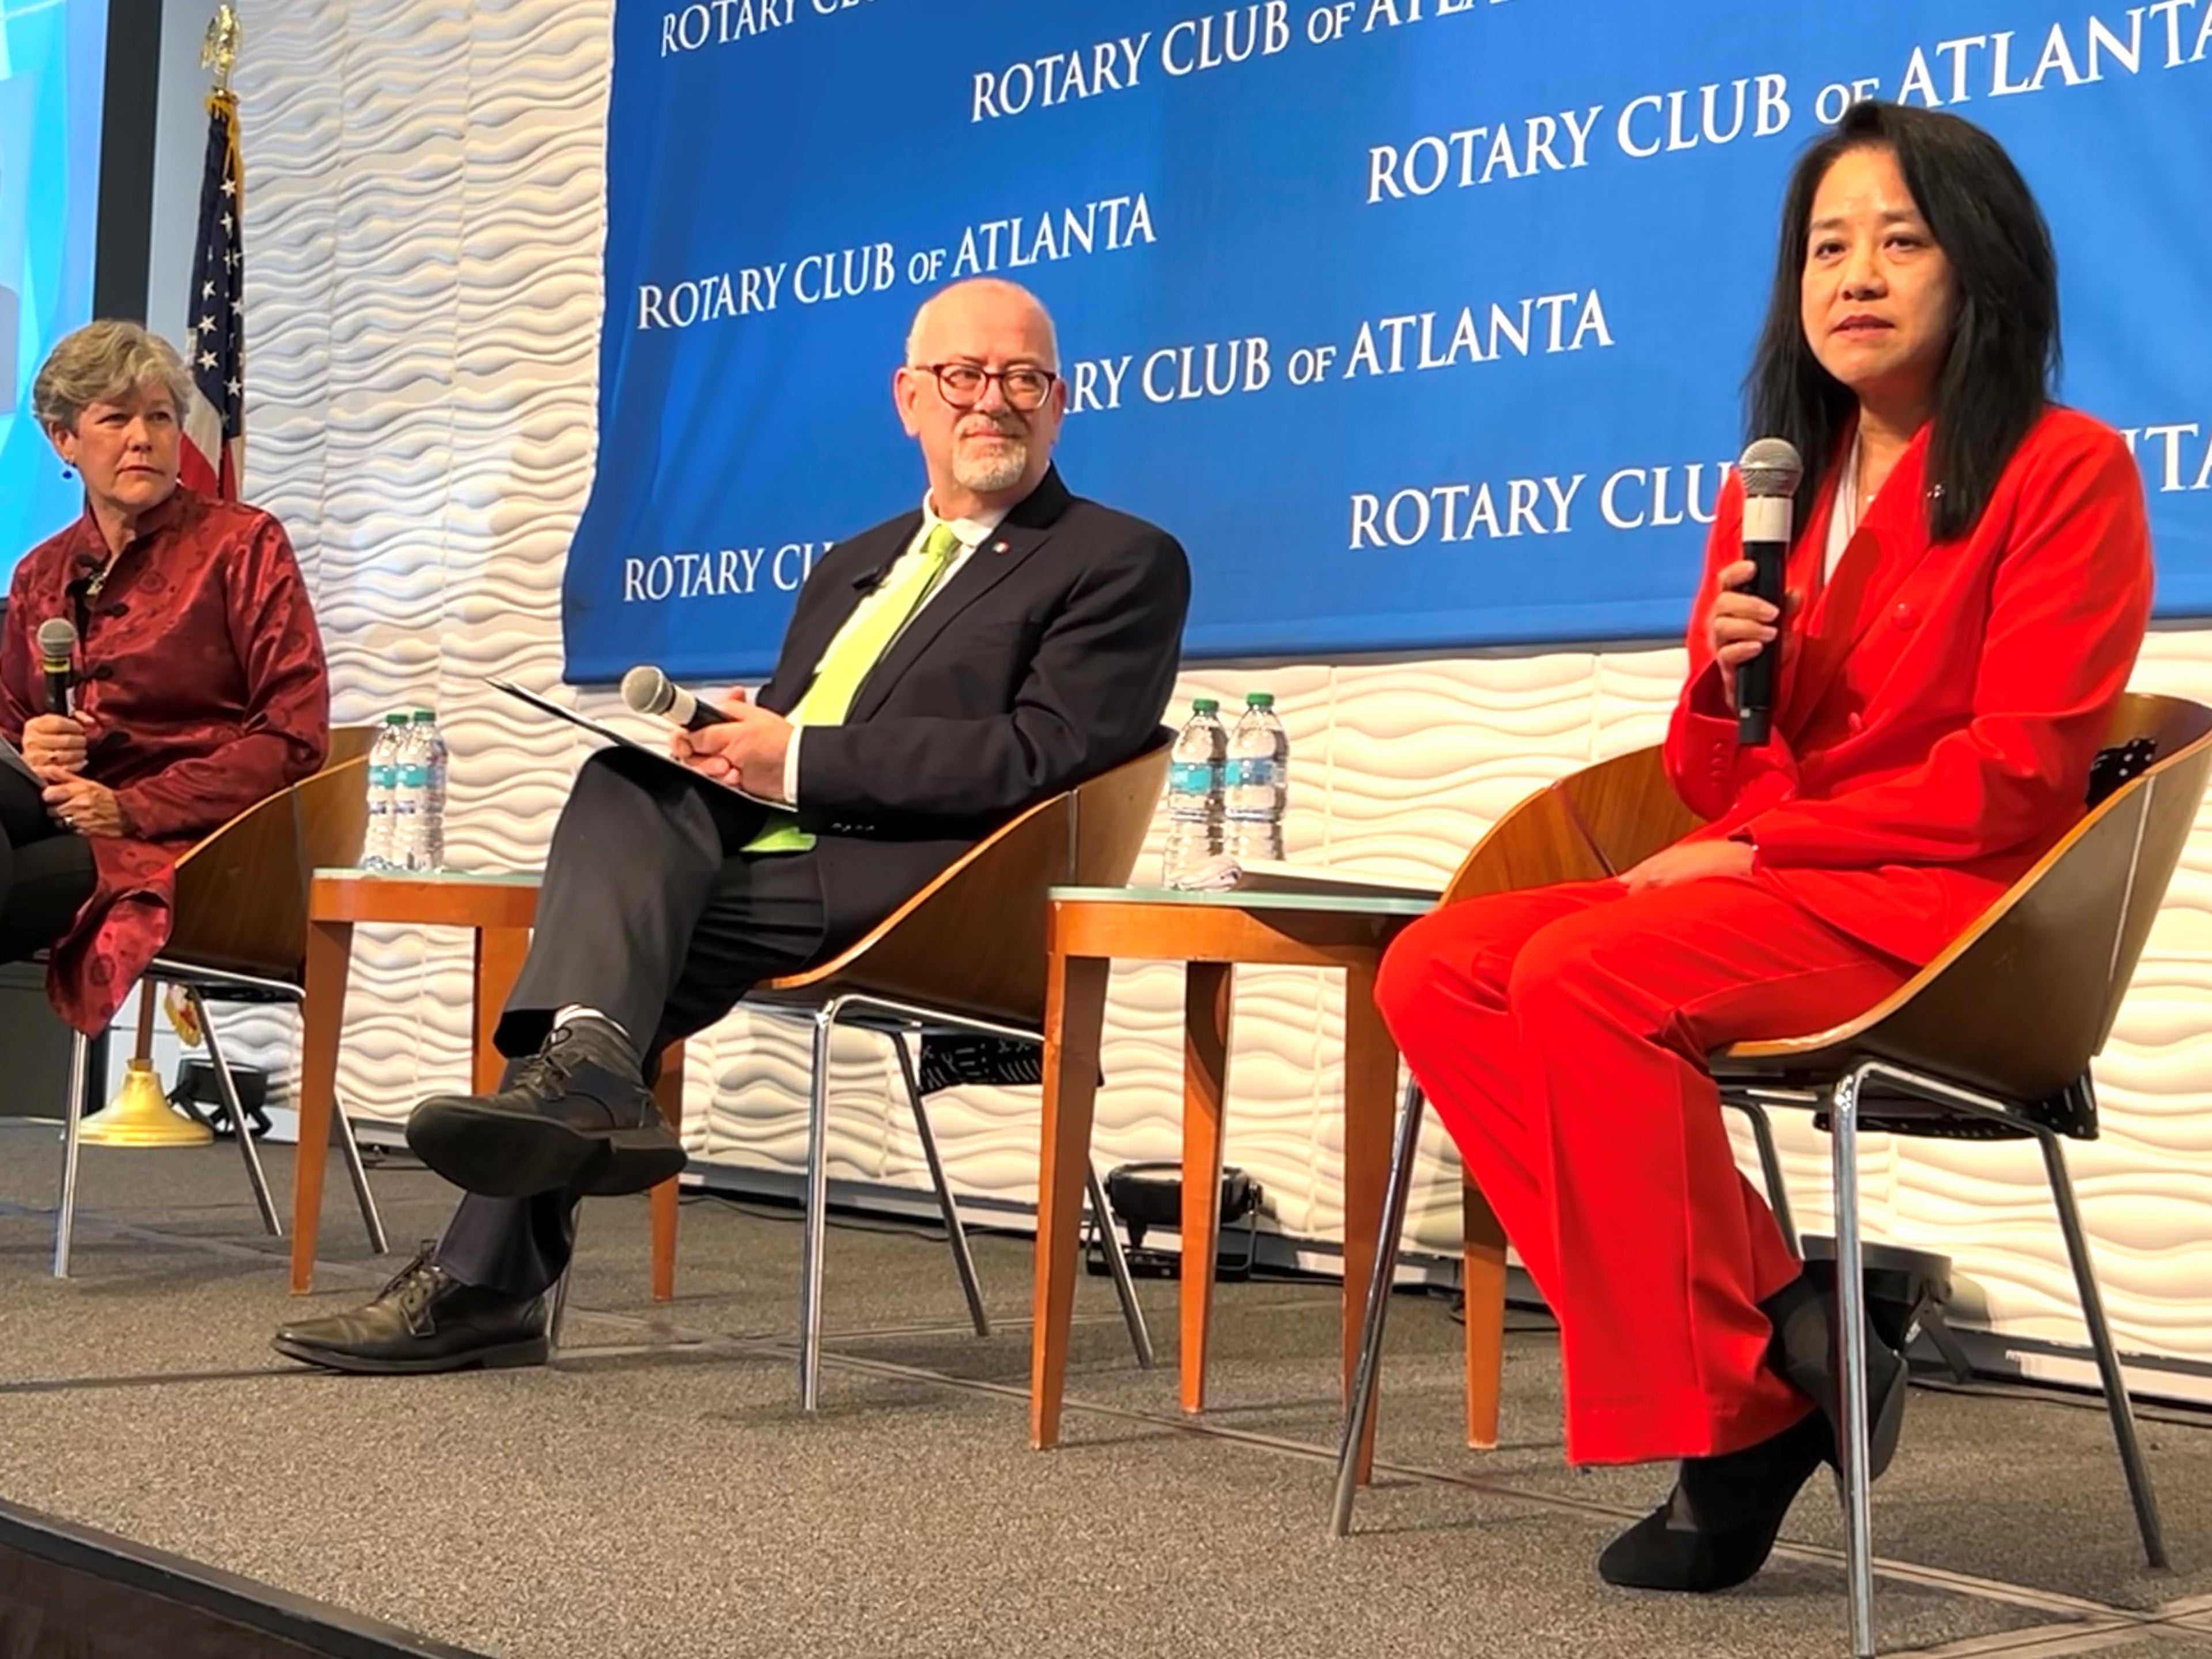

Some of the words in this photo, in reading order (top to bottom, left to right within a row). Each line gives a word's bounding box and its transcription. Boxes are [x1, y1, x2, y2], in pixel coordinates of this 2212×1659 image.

[971, 32, 1151, 123] ROTARY
[1161, 0, 1290, 76] CLUB
[1307, 2, 1355, 44] OF
[1366, 105, 1604, 204] ROTARY
[1617, 73, 1791, 158] CLUB
[1815, 77, 1880, 125] OF
[638, 263, 787, 329] ROTARY
[793, 242, 896, 304] CLUB
[908, 249, 946, 285] OF
[951, 192, 1157, 278] ATLANTA
[1142, 336, 1271, 404] CLUB
[1287, 346, 1337, 386] OF
[1343, 288, 1615, 380] ATLANTA
[1349, 474, 1586, 550] ROTARY
[1600, 461, 1735, 529] CLU
[624, 548, 766, 601] ROTARY
